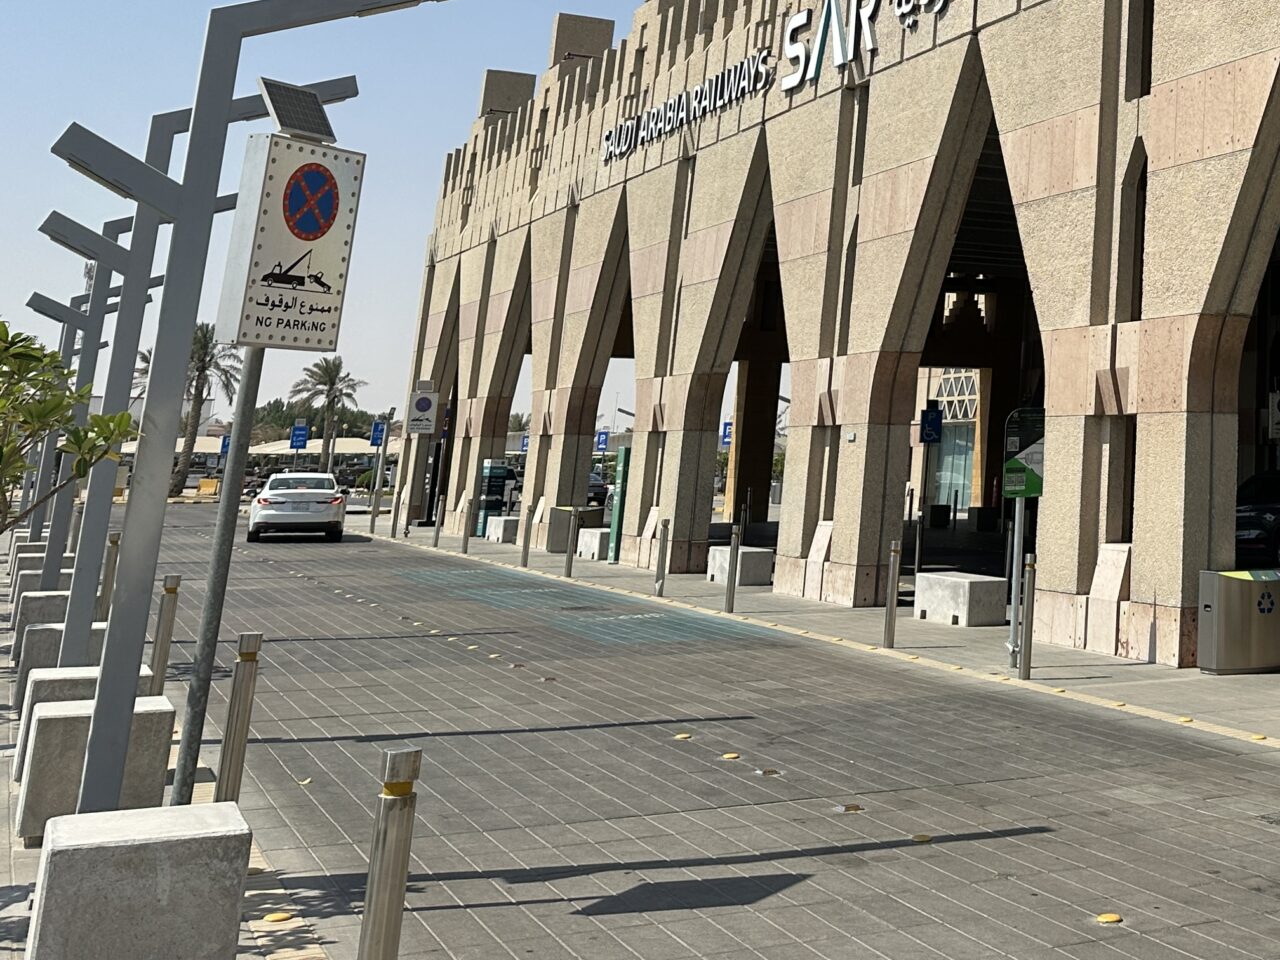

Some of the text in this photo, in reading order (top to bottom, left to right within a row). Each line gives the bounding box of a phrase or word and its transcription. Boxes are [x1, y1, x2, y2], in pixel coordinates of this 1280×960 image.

[602, 49, 770, 161] SAUDI ARABIA RAILWAYS
[255, 293, 332, 315] ممنوع الوقوف
